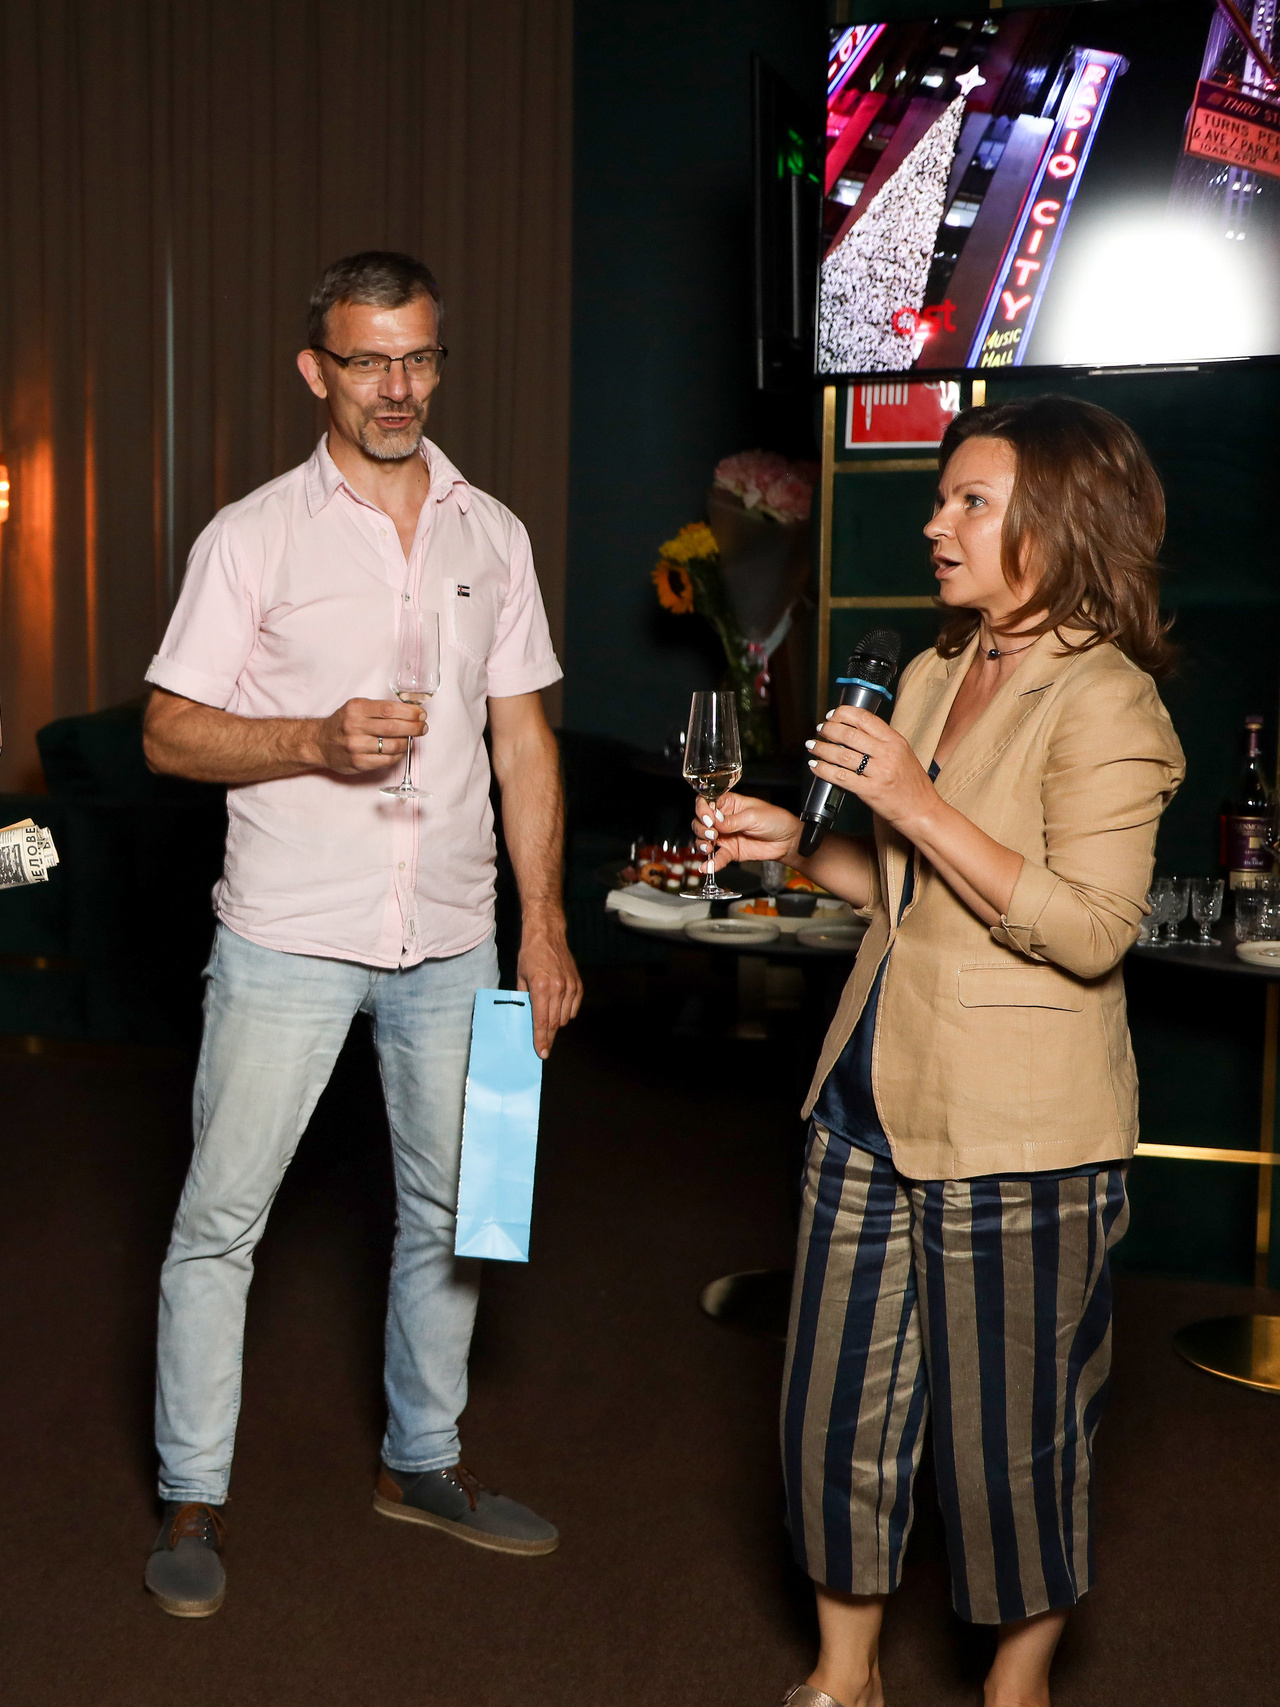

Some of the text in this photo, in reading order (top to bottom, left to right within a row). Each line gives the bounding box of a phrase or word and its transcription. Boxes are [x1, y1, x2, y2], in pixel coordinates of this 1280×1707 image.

[1223, 96, 1261, 116] THRU
[1204, 113, 1250, 137] TURNS
[1205, 129, 1226, 144] AVE
[1240, 140, 1269, 160] PARK
[1000, 63, 1107, 321] RADIO CITY
[982, 328, 1022, 351] MUSIC
[980, 349, 1014, 368] HALL
